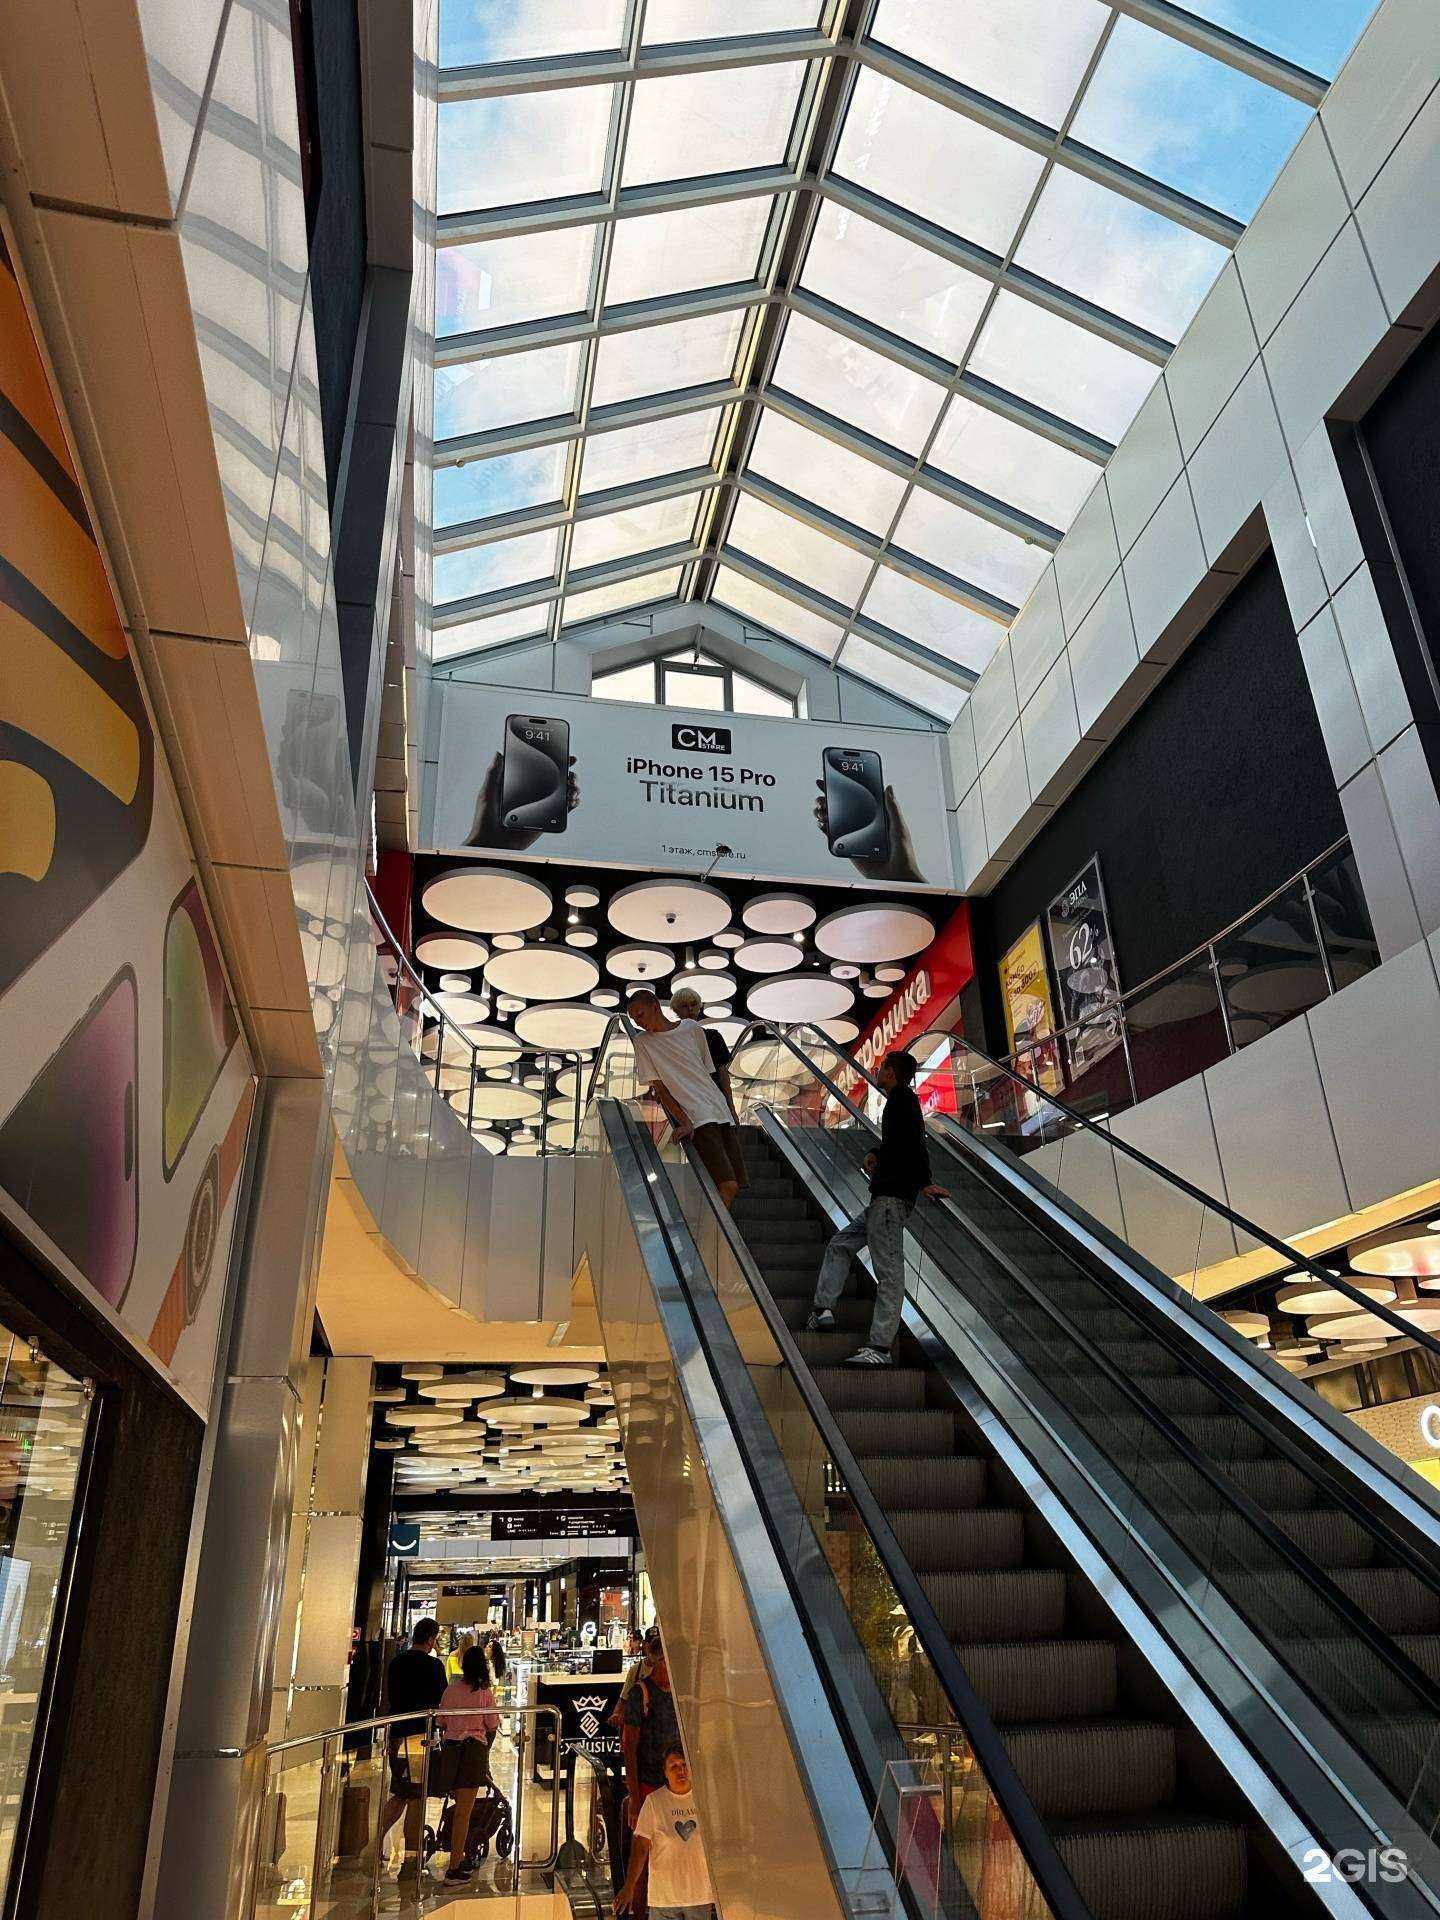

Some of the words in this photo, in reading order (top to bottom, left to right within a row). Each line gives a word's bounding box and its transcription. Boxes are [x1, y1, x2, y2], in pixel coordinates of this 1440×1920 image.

[525, 730, 551, 742] 9:41
[702, 743, 726, 751] STORE
[626, 757, 703, 780] iPhone
[708, 765, 735, 783] 15
[740, 768, 776, 787] Pro
[841, 761, 864, 773] 9:41
[639, 779, 764, 812] Titanium
[668, 846, 695, 856] этаж,
